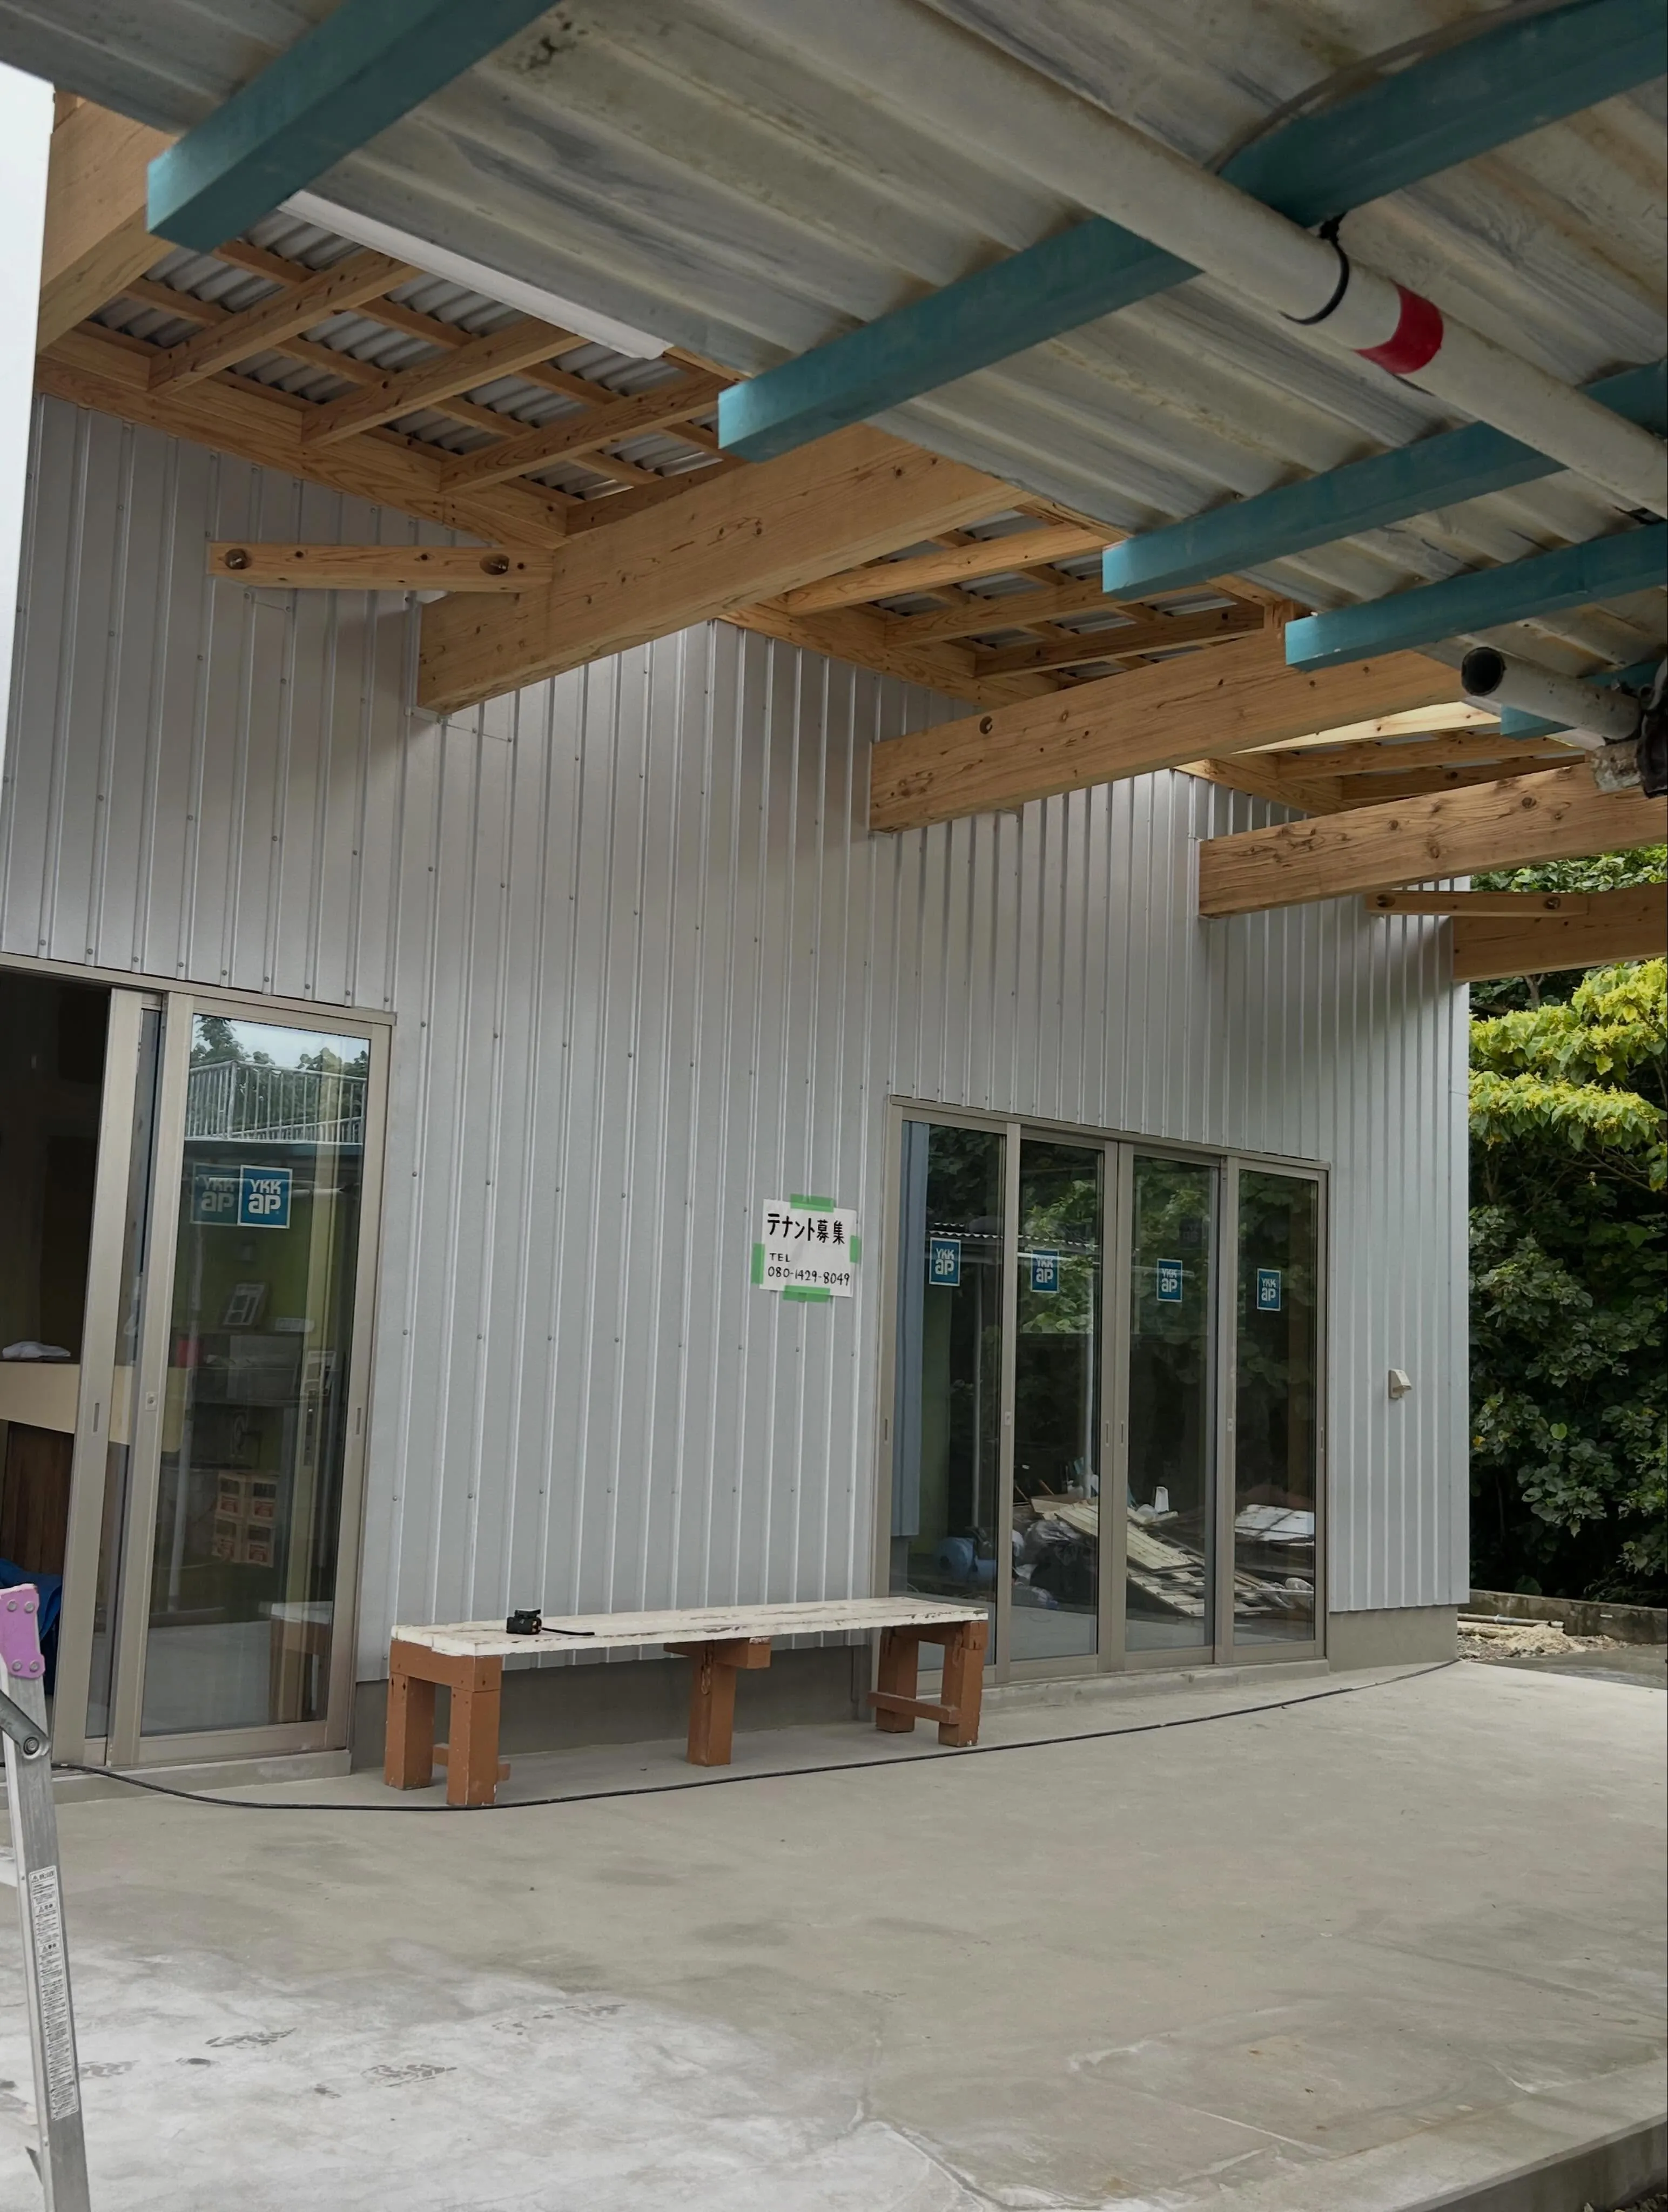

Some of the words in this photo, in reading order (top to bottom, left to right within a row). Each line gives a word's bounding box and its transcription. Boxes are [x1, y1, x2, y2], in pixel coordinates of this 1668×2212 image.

[250, 1179, 281, 1195] YKK
[248, 1193, 281, 1215] ap
[767, 1213, 845, 1245] テナント募集
[769, 1252, 791, 1263] TEL
[936, 1248, 954, 1259] YKK
[934, 1259, 954, 1275] ap
[1036, 1256, 1054, 1268] YKK
[768, 1266, 850, 1286] 080-1429-8049
[1035, 1267, 1054, 1284] ap
[1261, 1278, 1276, 1288] YKK
[1161, 1278, 1178, 1292] ap
[1261, 1287, 1276, 1301] ap
